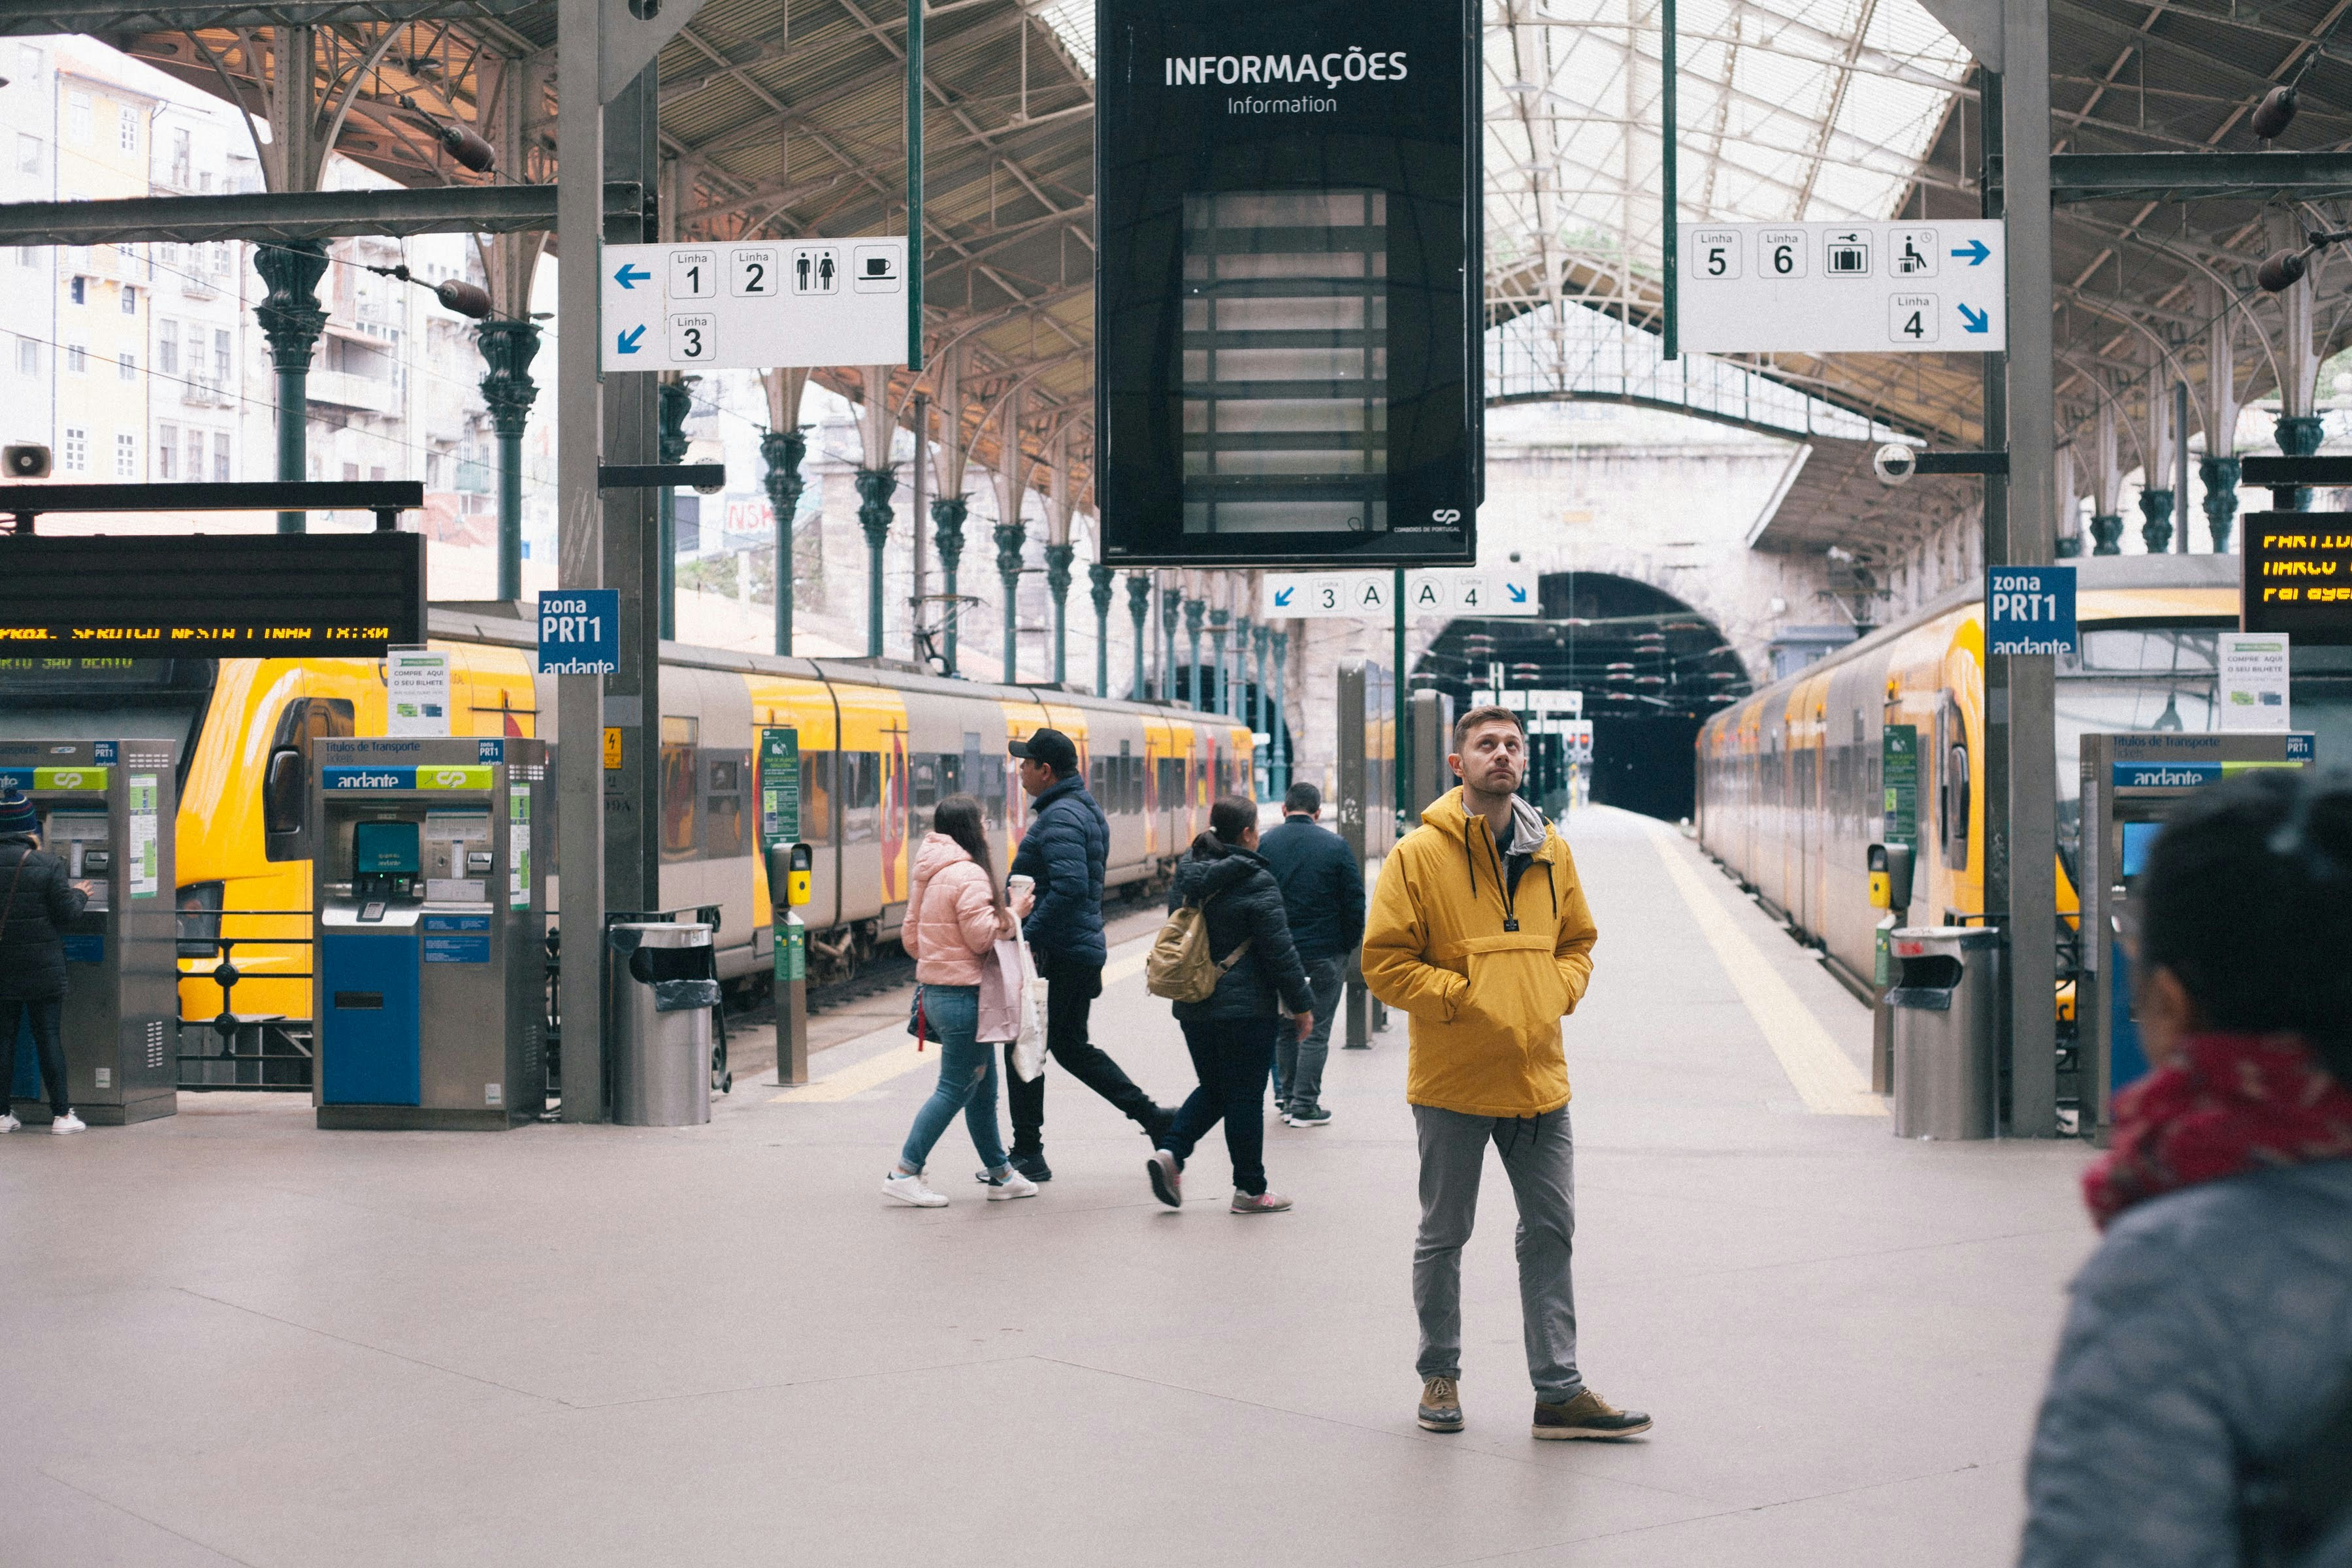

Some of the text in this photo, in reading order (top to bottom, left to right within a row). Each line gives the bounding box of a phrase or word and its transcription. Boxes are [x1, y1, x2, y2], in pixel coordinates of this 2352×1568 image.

[1165, 46, 1408, 89] INFORMAÇÕES
[1228, 95, 1337, 114] Information
[1701, 234, 1733, 244] Linha
[1766, 234, 1799, 244] Linha
[678, 254, 707, 263] Linha
[739, 252, 768, 262] Linha
[1708, 248, 1727, 276] 5
[1774, 246, 1793, 274] 6
[687, 266, 698, 293] 1
[745, 263, 763, 291] 2
[1897, 297, 1929, 307] Linha
[678, 317, 707, 327] Linha
[1904, 312, 1923, 338] 4
[683, 329, 702, 357] 3
[1993, 576, 2041, 591] zona
[1322, 589, 1335, 608] 3
[1364, 585, 1380, 605] A
[1418, 585, 1436, 604] A
[1464, 588, 1477, 607] 4
[542, 600, 587, 614] zona
[1993, 593, 2056, 622] PRT1
[542, 616, 601, 643] PRT1
[1993, 636, 2072, 654] andante
[544, 657, 615, 674] andante
[326, 742, 421, 753] Títulos de Transporte
[2114, 736, 2220, 749] Títulos de Transporte
[2287, 743, 2308, 753] PRT1
[95, 749, 114, 758] PRT1
[326, 753, 353, 763] Tickets
[480, 747, 498, 757] PRT1
[338, 772, 399, 788] andante
[2134, 768, 2203, 785] andante
